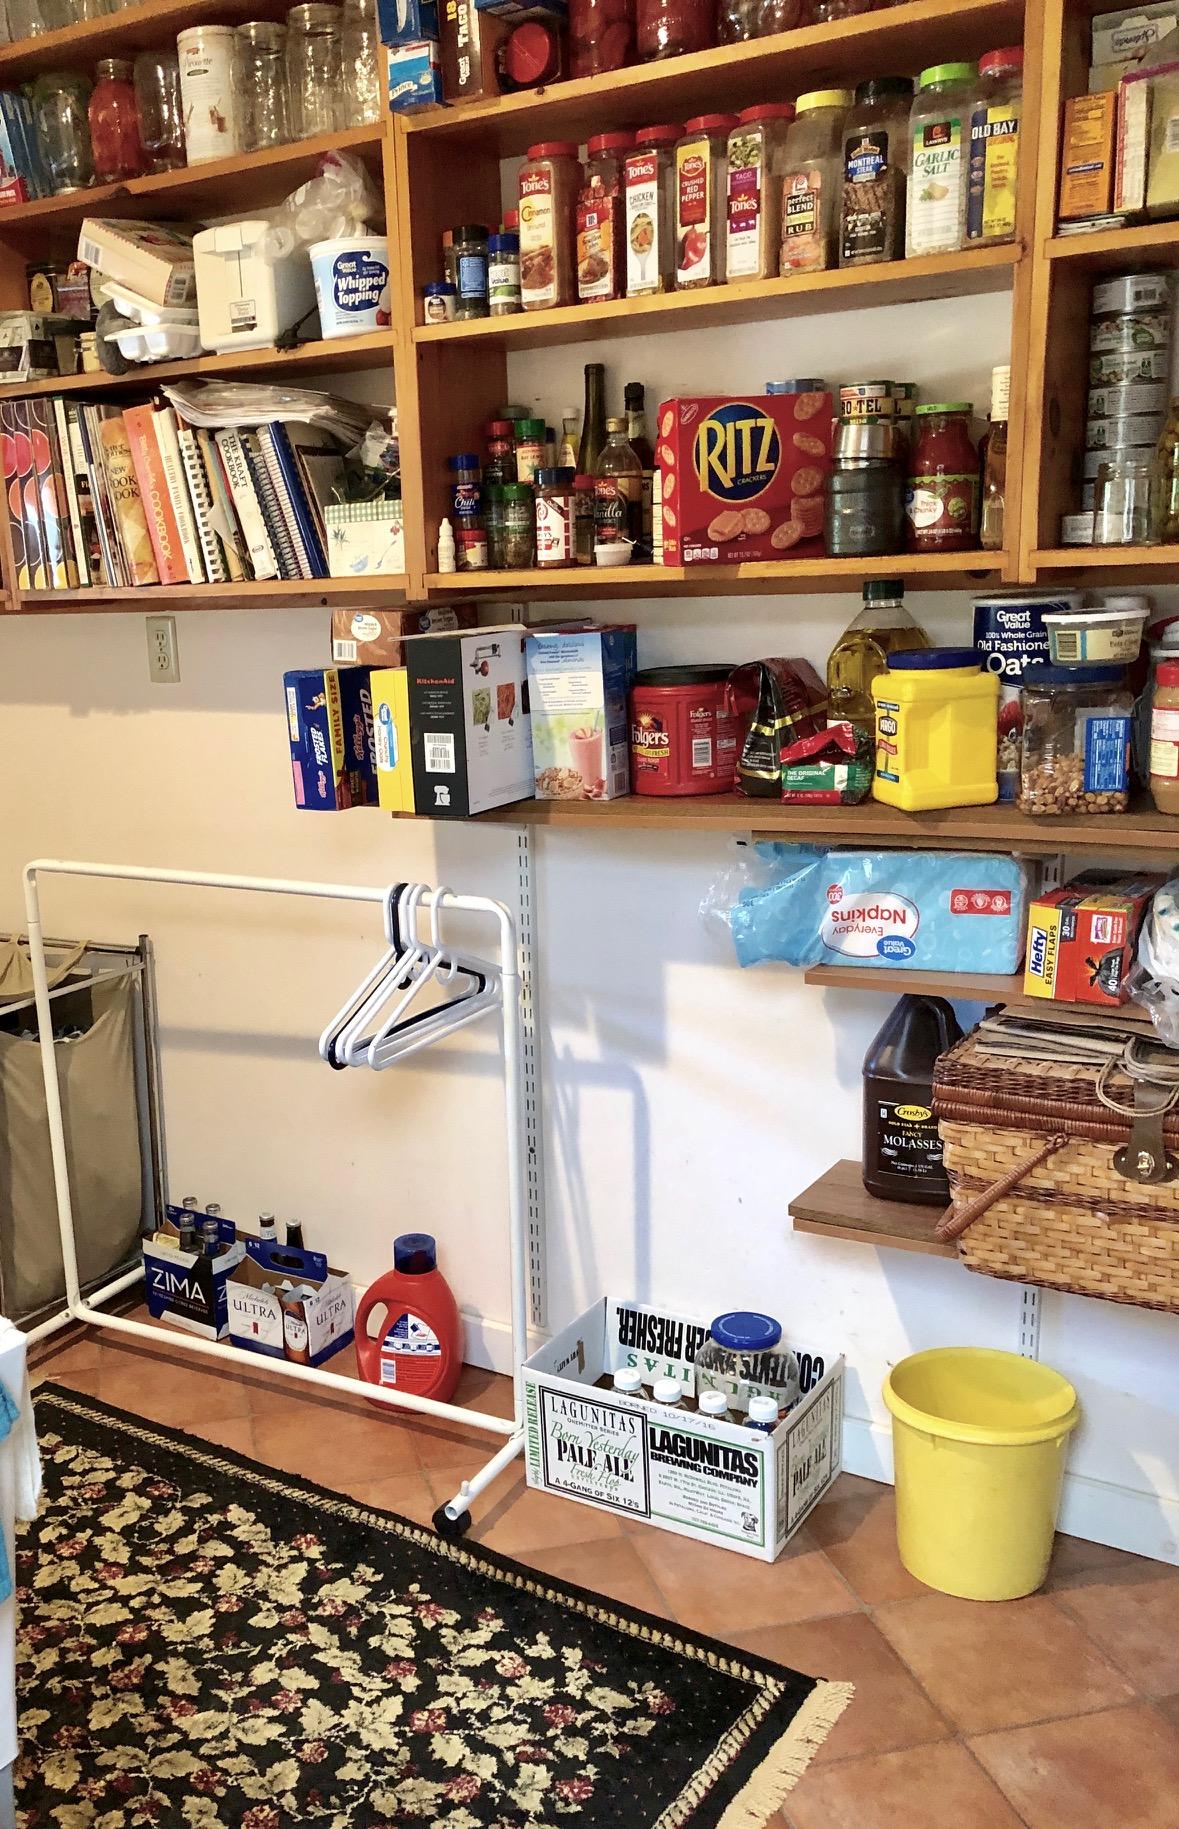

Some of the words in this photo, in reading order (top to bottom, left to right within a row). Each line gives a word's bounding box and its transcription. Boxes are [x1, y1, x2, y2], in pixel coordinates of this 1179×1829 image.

[458, 4, 468, 47] TACO
[972, 125, 991, 140] OLD
[993, 121, 1015, 135] BAY
[848, 155, 884, 170] MONTREAL
[915, 148, 960, 167] GARLIC
[628, 162, 654, 180] Tone's
[924, 162, 950, 176] SALT
[521, 179, 549, 194] Tone's
[687, 186, 698, 194] RED
[630, 191, 654, 205] CHICKEN
[682, 192, 704, 202] PEPPER
[730, 198, 758, 214] Tone's
[788, 202, 813, 214] BLEND
[337, 262, 356, 270] Great
[338, 272, 385, 291] Whipped
[338, 288, 378, 306] Topping
[228, 434, 238, 454] THE
[234, 456, 248, 487] KRAFT
[699, 418, 775, 492] RITZ
[222, 439, 240, 490] COOKBOOK
[112, 475, 137, 488] OOK
[115, 488, 140, 500] OOK
[454, 497, 475, 509] Chili
[150, 491, 172, 560] COOKBOOK
[996, 610, 1031, 622] Great
[978, 640, 991, 651] Old
[995, 640, 1050, 651] Fashione
[328, 675, 338, 704] SIZE
[332, 708, 343, 754] FAMILY
[632, 724, 669, 748] Folgers
[880, 720, 896, 734] ARGO
[310, 727, 323, 765] FROSTED
[316, 730, 328, 763] FLAKES
[832, 905, 906, 924] Napkins
[832, 924, 884, 936] Everyday
[1062, 926, 1070, 937] 30
[1048, 925, 1057, 956] FLAPS
[883, 945, 912, 956] Great
[1031, 930, 1047, 974] Hefty
[1045, 960, 1054, 985] EASY
[1108, 979, 1117, 991] 40
[898, 1107, 929, 1118] Crosby's
[883, 1134, 943, 1150] MOLASSES
[902, 1130, 923, 1138] FANCY
[151, 1267, 206, 1304] ZIMA
[233, 1299, 277, 1320] ULTRA
[316, 1300, 346, 1326] ULTRA
[286, 1325, 305, 1333] ULTRA
[616, 1307, 684, 1360] FRESHER.
[525, 1381, 538, 1426] RELEASE
[552, 1396, 635, 1434] LAGUNITAS
[663, 1412, 717, 1430] 10/17/16
[600, 1426, 619, 1436] SERIES
[528, 1426, 540, 1468] LIMITED
[550, 1420, 581, 1444] Born
[586, 1431, 639, 1473] Yesterday
[649, 1426, 759, 1477] LAGUNITAS
[557, 1439, 597, 1469] PALE
[604, 1454, 634, 1482] ALE
[651, 1451, 701, 1473] BREWING
[703, 1466, 758, 1488] COMPANY
[564, 1480, 592, 1494] 4-GANG
